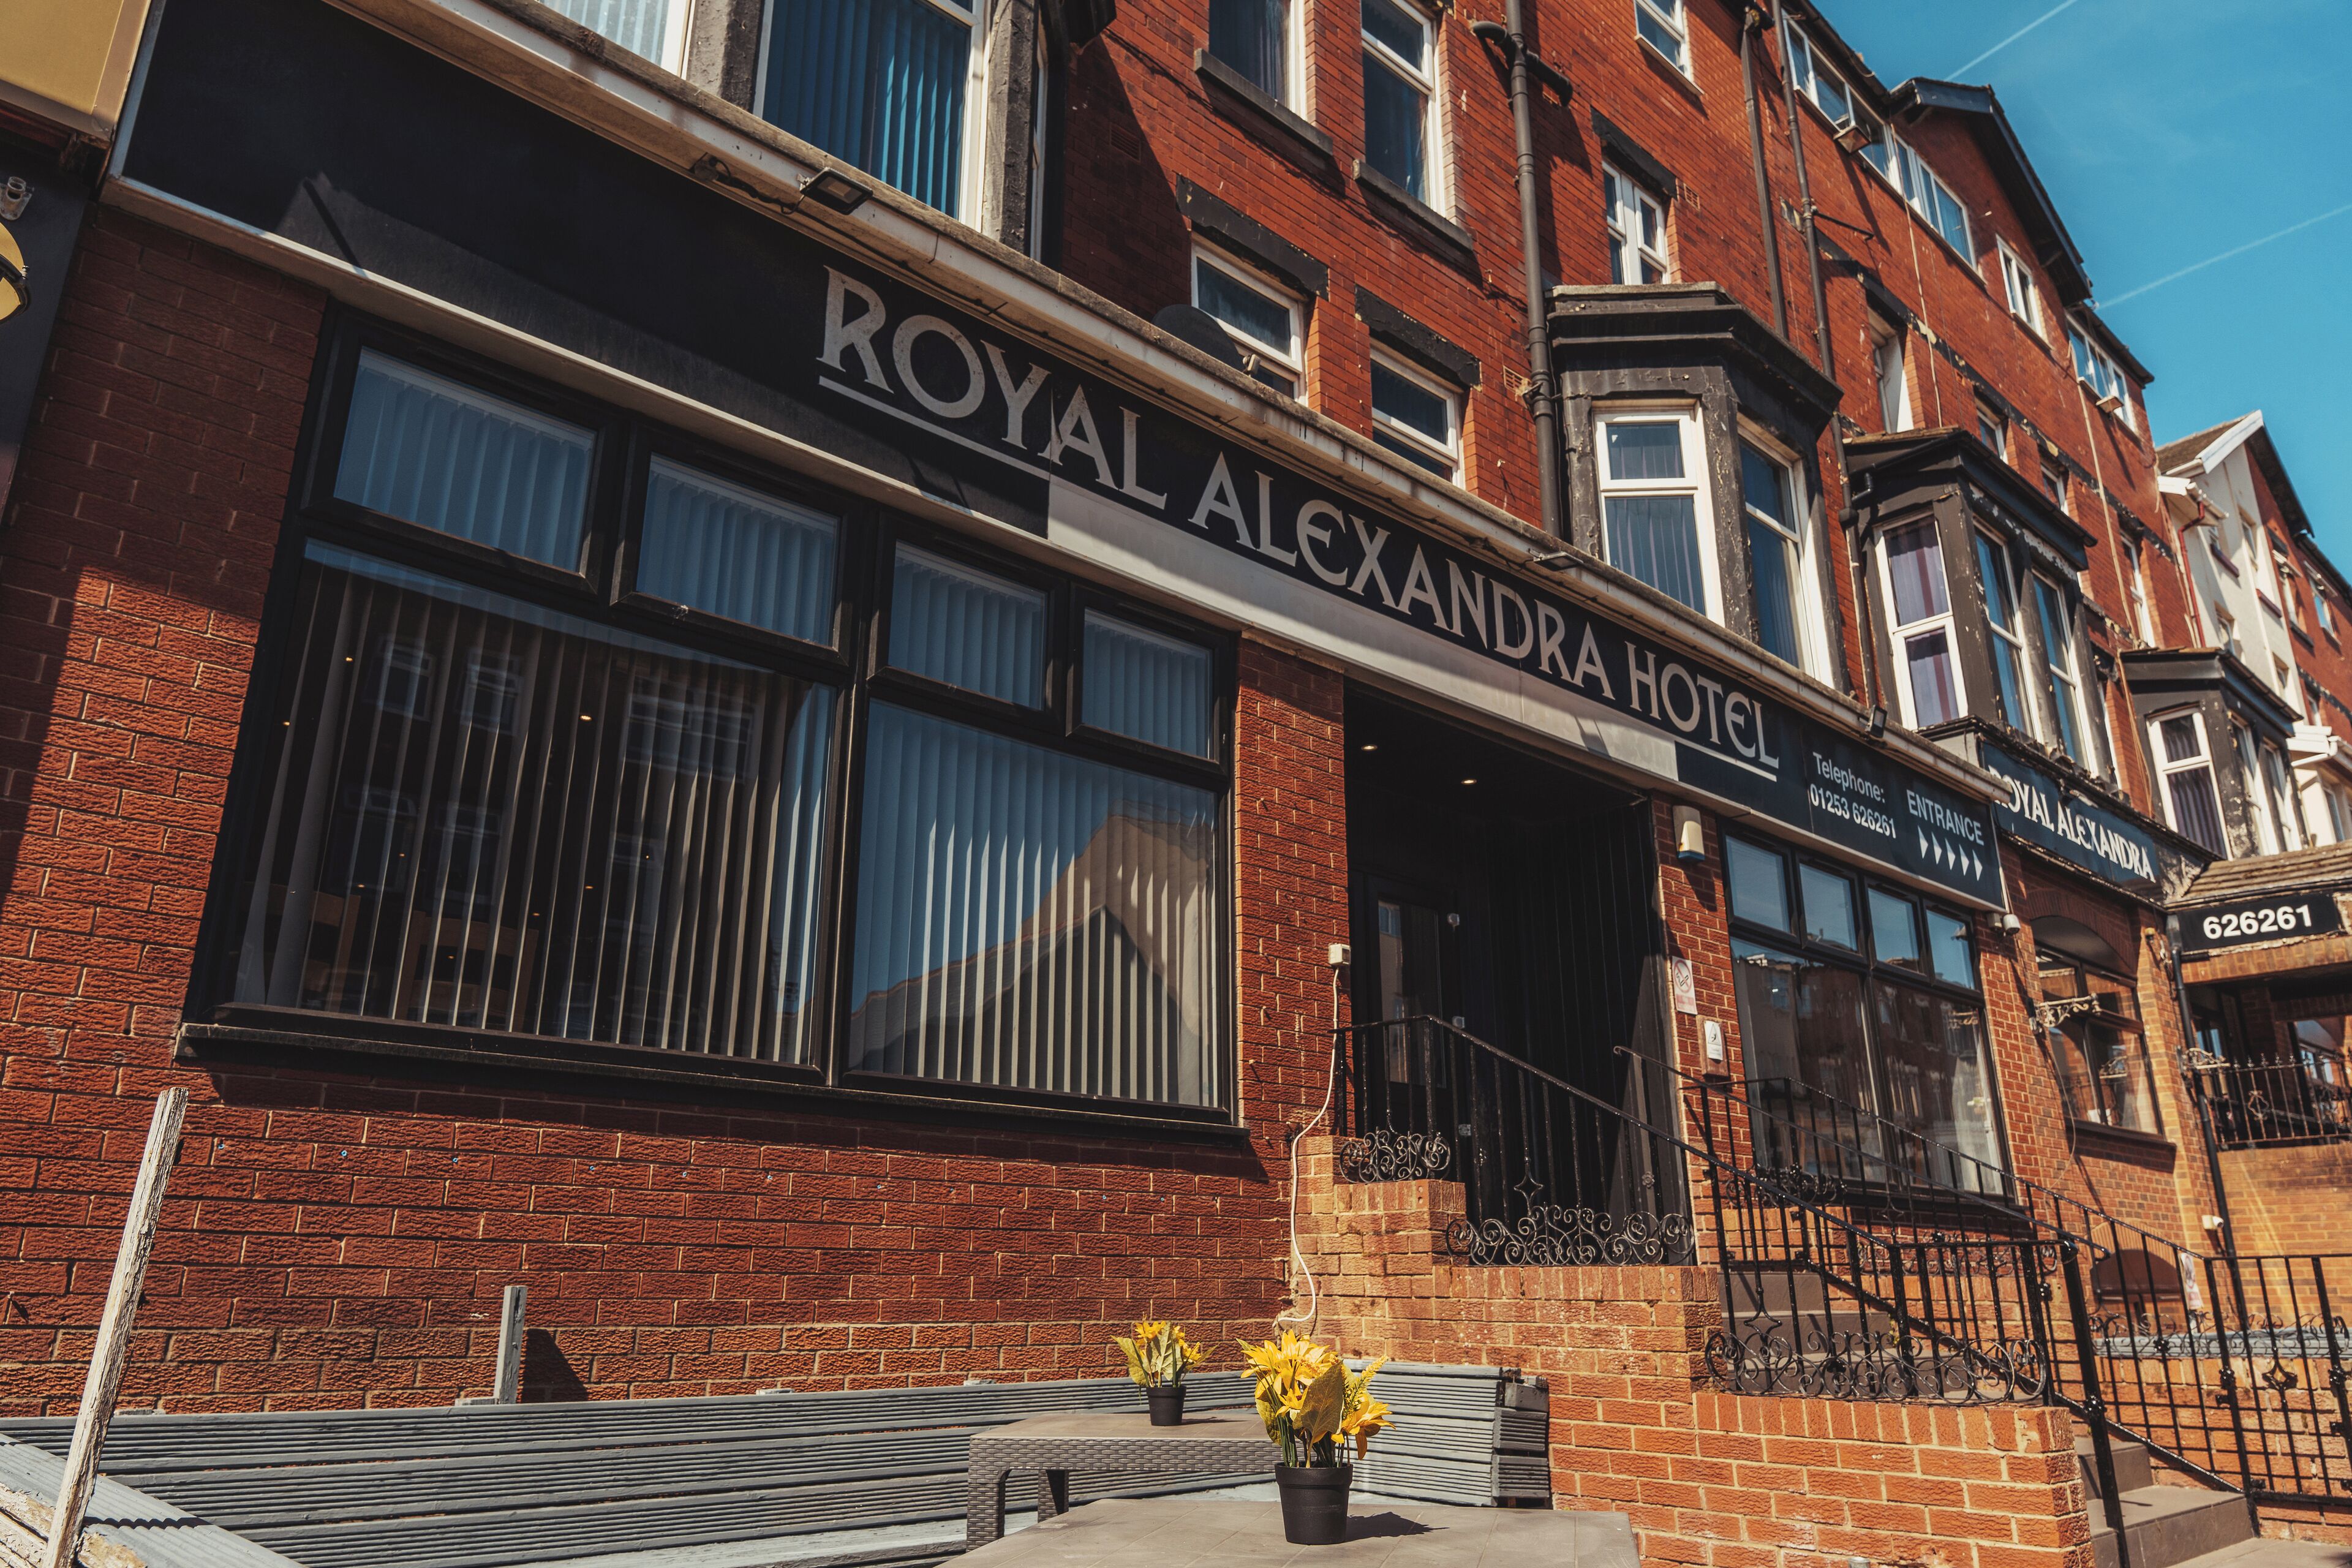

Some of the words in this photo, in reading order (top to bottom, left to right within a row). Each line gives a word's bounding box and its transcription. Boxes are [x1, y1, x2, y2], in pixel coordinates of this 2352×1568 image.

[816, 265, 1167, 510] ROYAL
[1188, 451, 1616, 700] ALEXANDRA
[1625, 640, 1779, 769] HOTEL
[1812, 752, 1886, 804] Telephone:
[1810, 783, 1850, 820] 01253
[1852, 802, 1897, 839] 626261
[1905, 789, 1985, 846] ENTRANCE
[2057, 800, 2156, 883] ALEXANDRA
[2203, 904, 2312, 940] 626261
